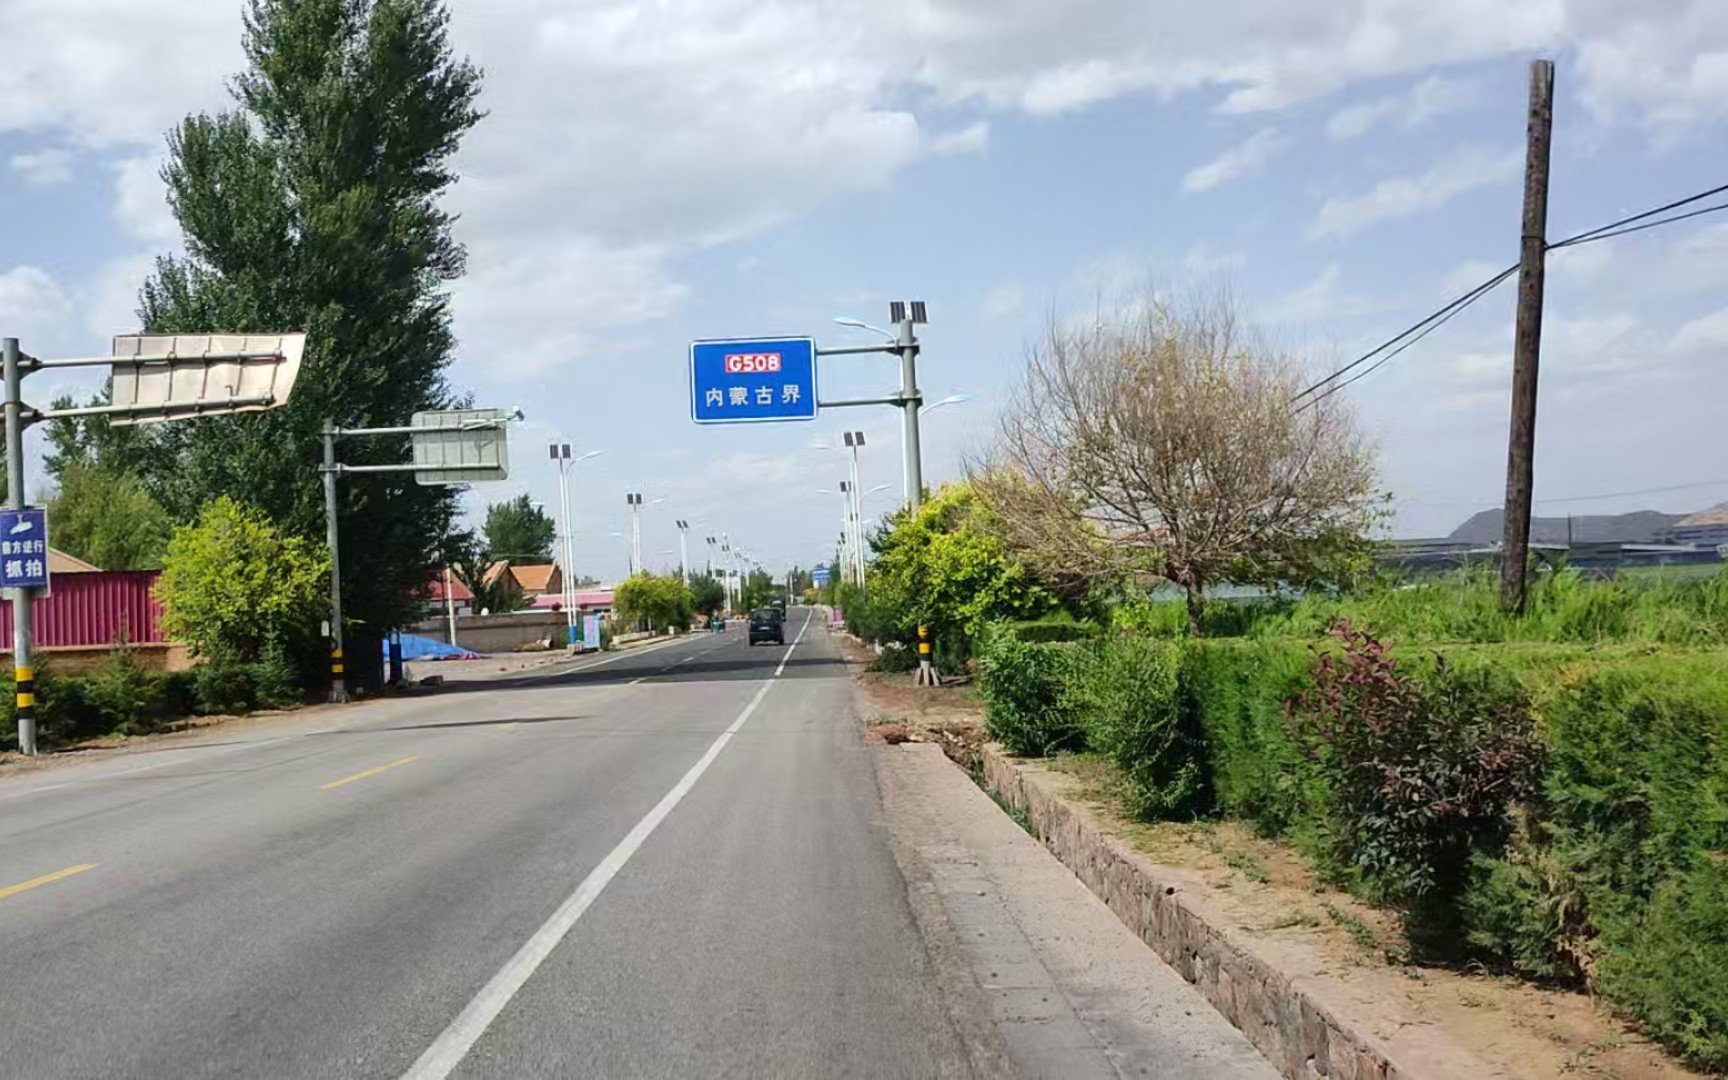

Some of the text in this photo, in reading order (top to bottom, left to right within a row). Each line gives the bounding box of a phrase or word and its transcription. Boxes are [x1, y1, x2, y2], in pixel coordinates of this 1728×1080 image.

[728, 355, 780, 371] G508
[705, 384, 801, 407] 内蒙古界
[5, 559, 43, 578] 抓拍
